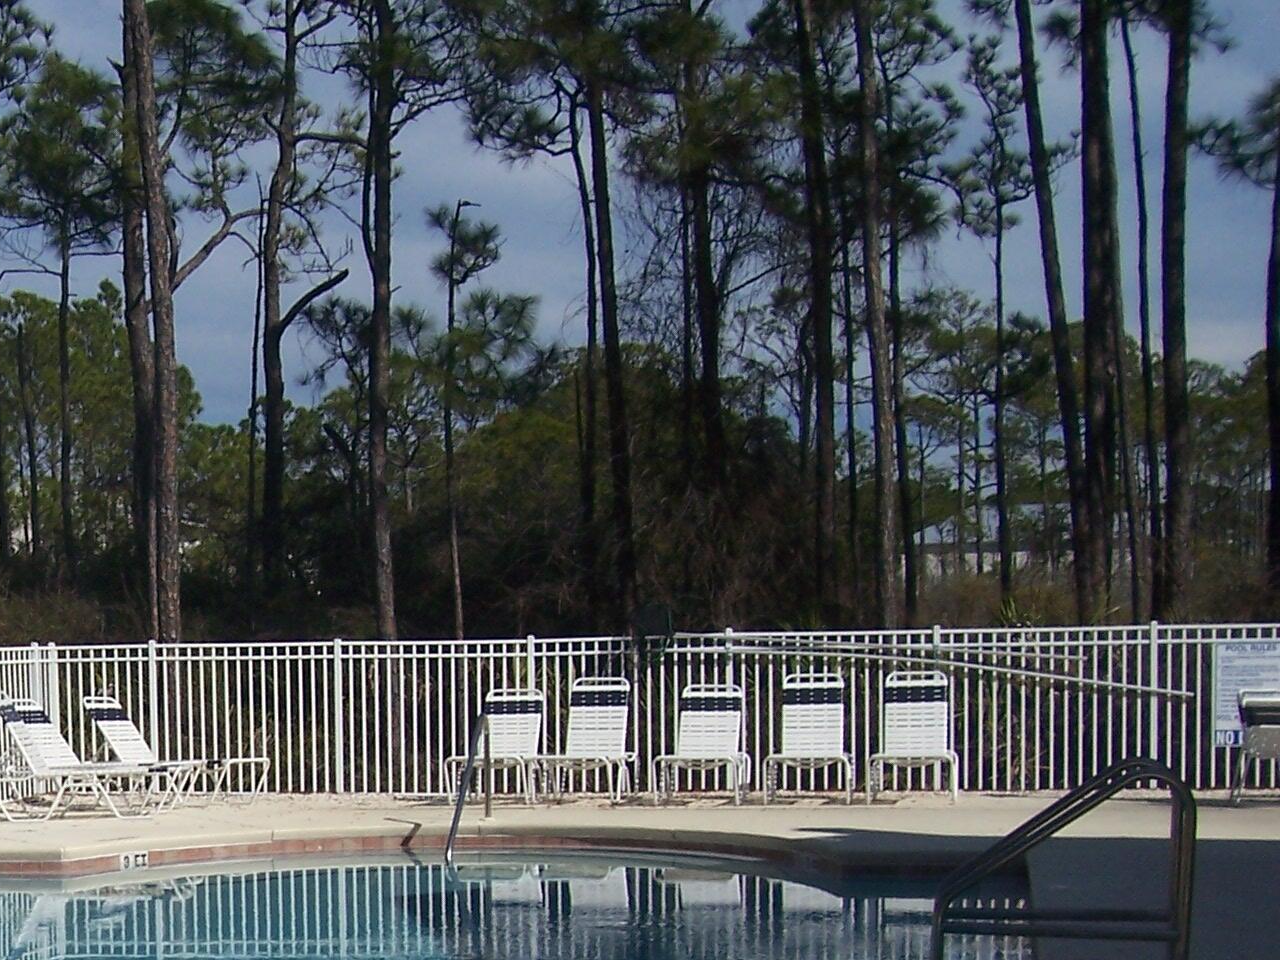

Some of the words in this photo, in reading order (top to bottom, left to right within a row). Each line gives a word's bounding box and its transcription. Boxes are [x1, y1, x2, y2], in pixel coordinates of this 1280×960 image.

[1225, 644, 1247, 652] POOL
[1250, 644, 1278, 652] RULES
[1216, 730, 1234, 745] NO
